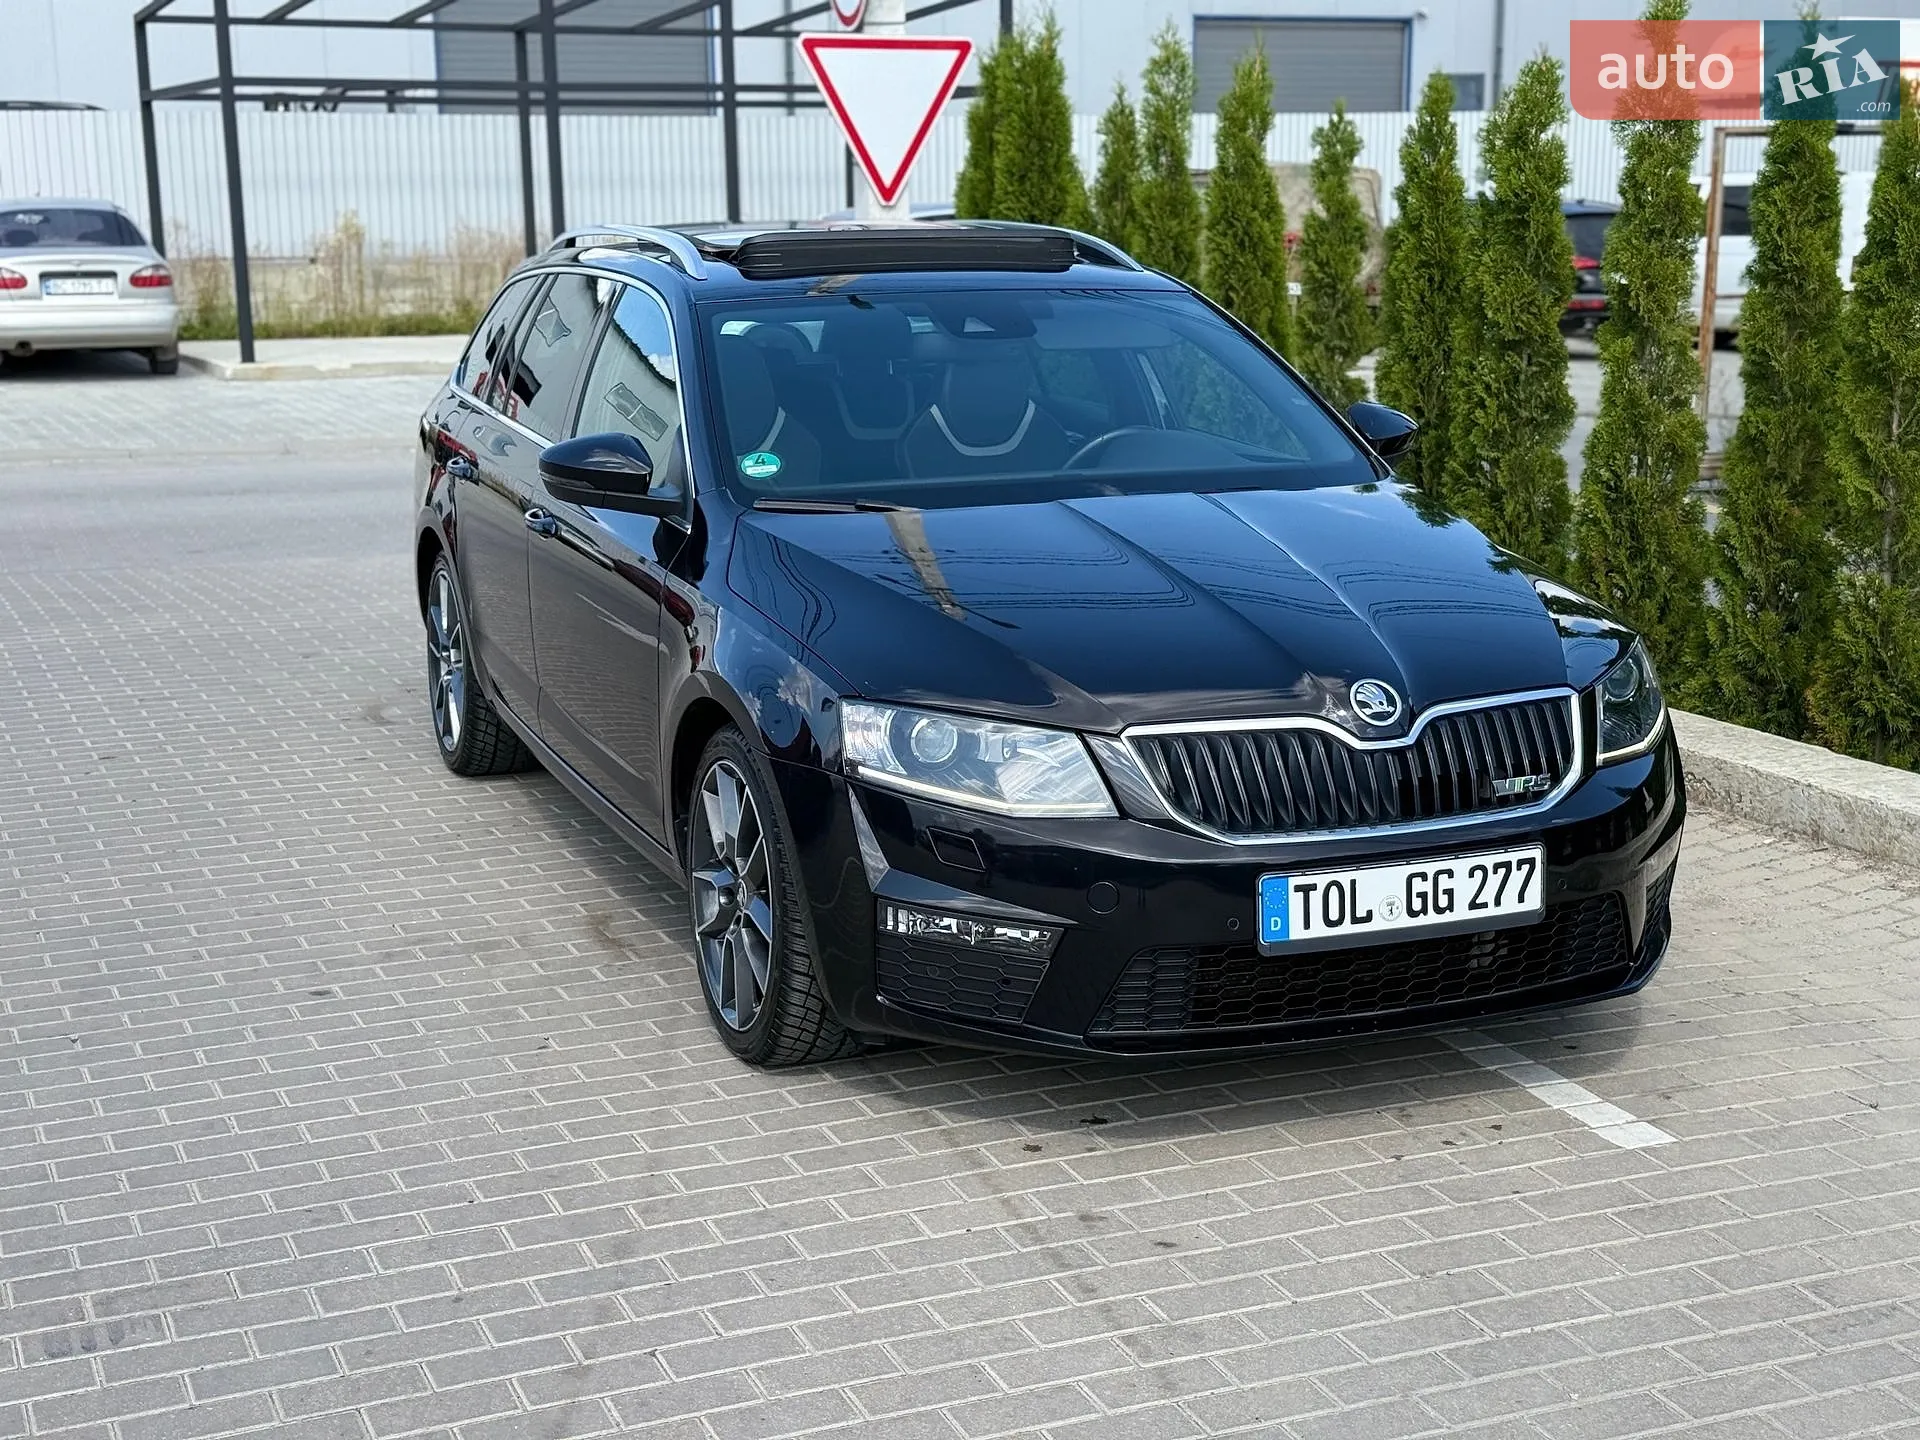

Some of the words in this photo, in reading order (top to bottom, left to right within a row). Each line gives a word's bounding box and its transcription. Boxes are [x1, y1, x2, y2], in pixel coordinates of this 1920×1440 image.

[754, 453, 767, 466] 4
[1293, 878, 1374, 931] TOL
[1405, 869, 1455, 919] GG
[1467, 856, 1537, 911] 277
[1270, 917, 1282, 932] D
